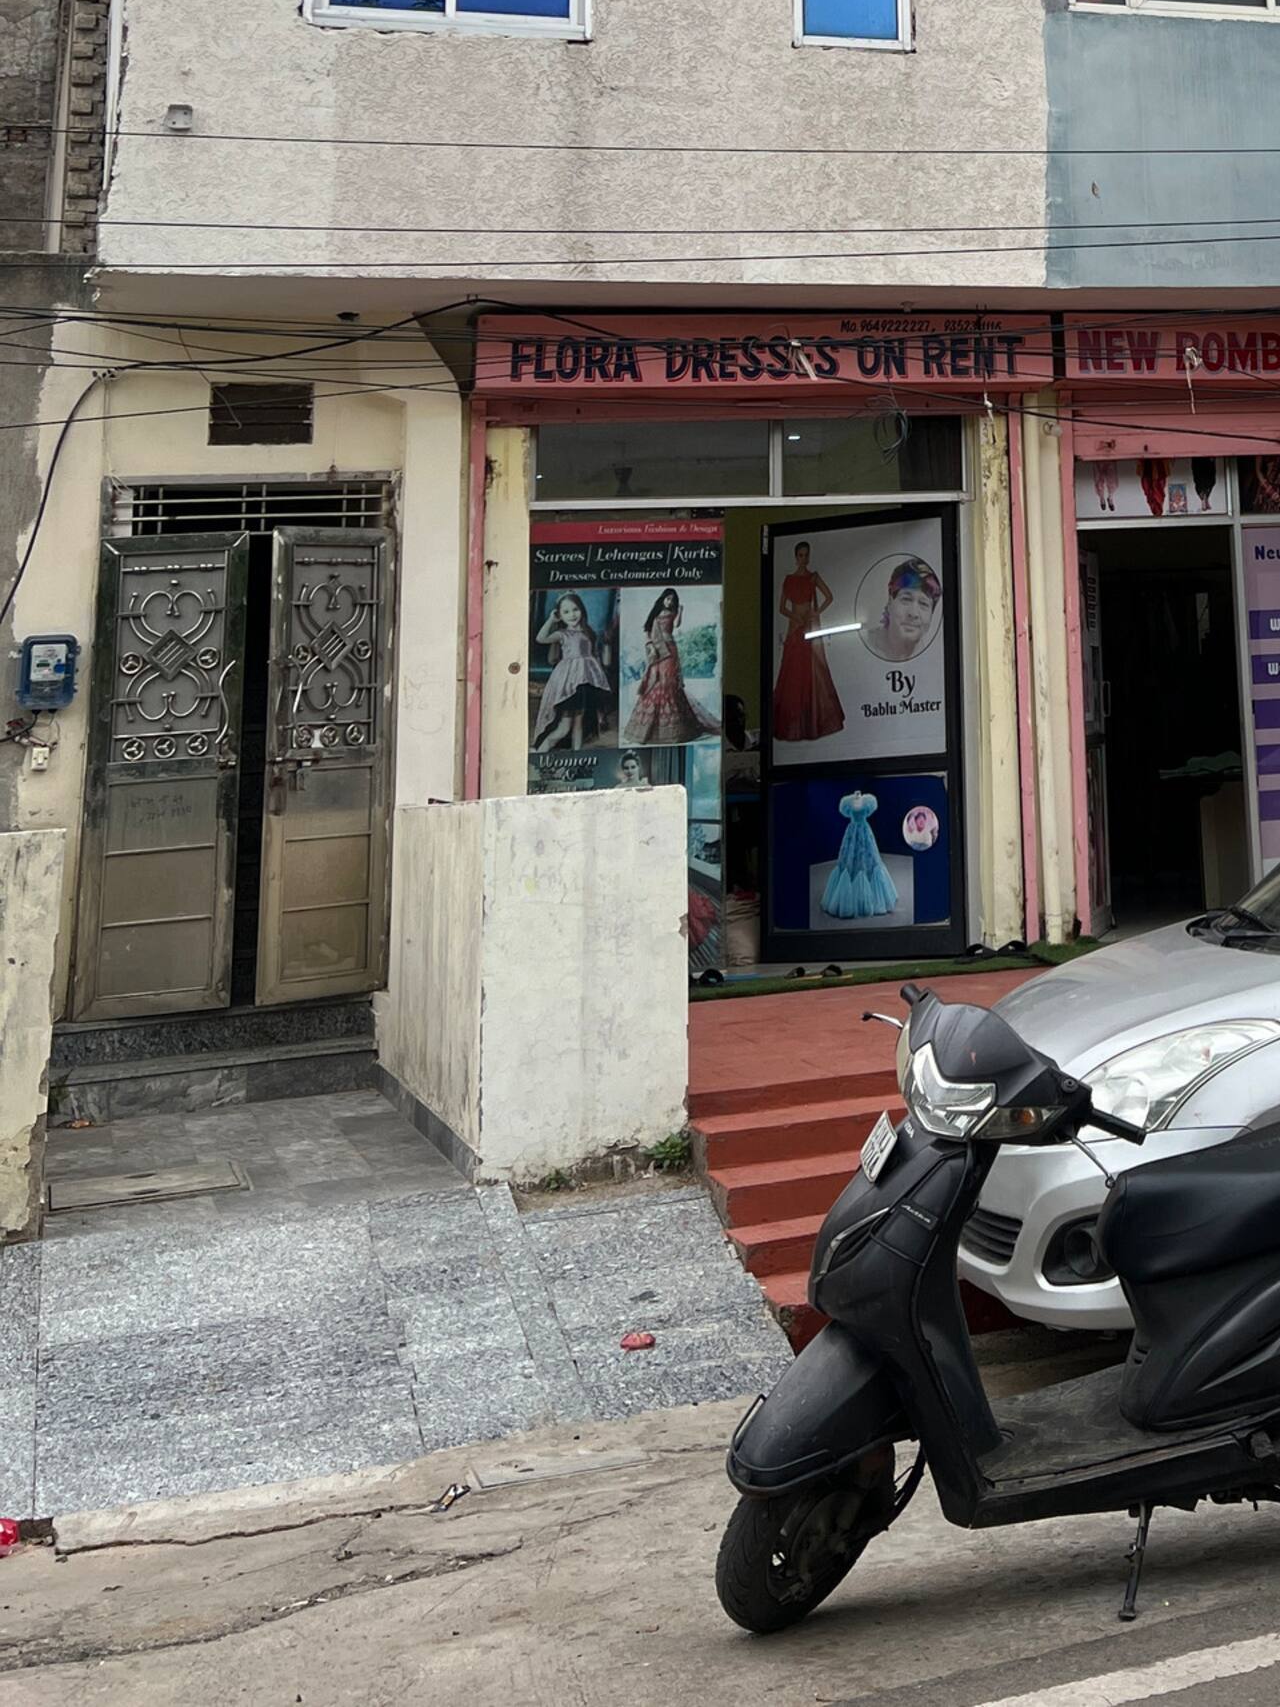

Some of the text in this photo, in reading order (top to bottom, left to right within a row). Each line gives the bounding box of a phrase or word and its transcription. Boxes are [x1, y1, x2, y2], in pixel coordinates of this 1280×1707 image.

[511, 334, 1025, 383] FLORA DRESSES ON RENT
[1078, 329, 1163, 375] NEW
[534, 550, 586, 564] Sarees
[595, 547, 664, 562] Lehengas
[672, 546, 718, 562] Kurtis
[549, 566, 704, 583] Dresses Customized Only
[886, 670, 915, 697] By
[861, 697, 942, 718] Bablu Master
[538, 755, 597, 769] Women
